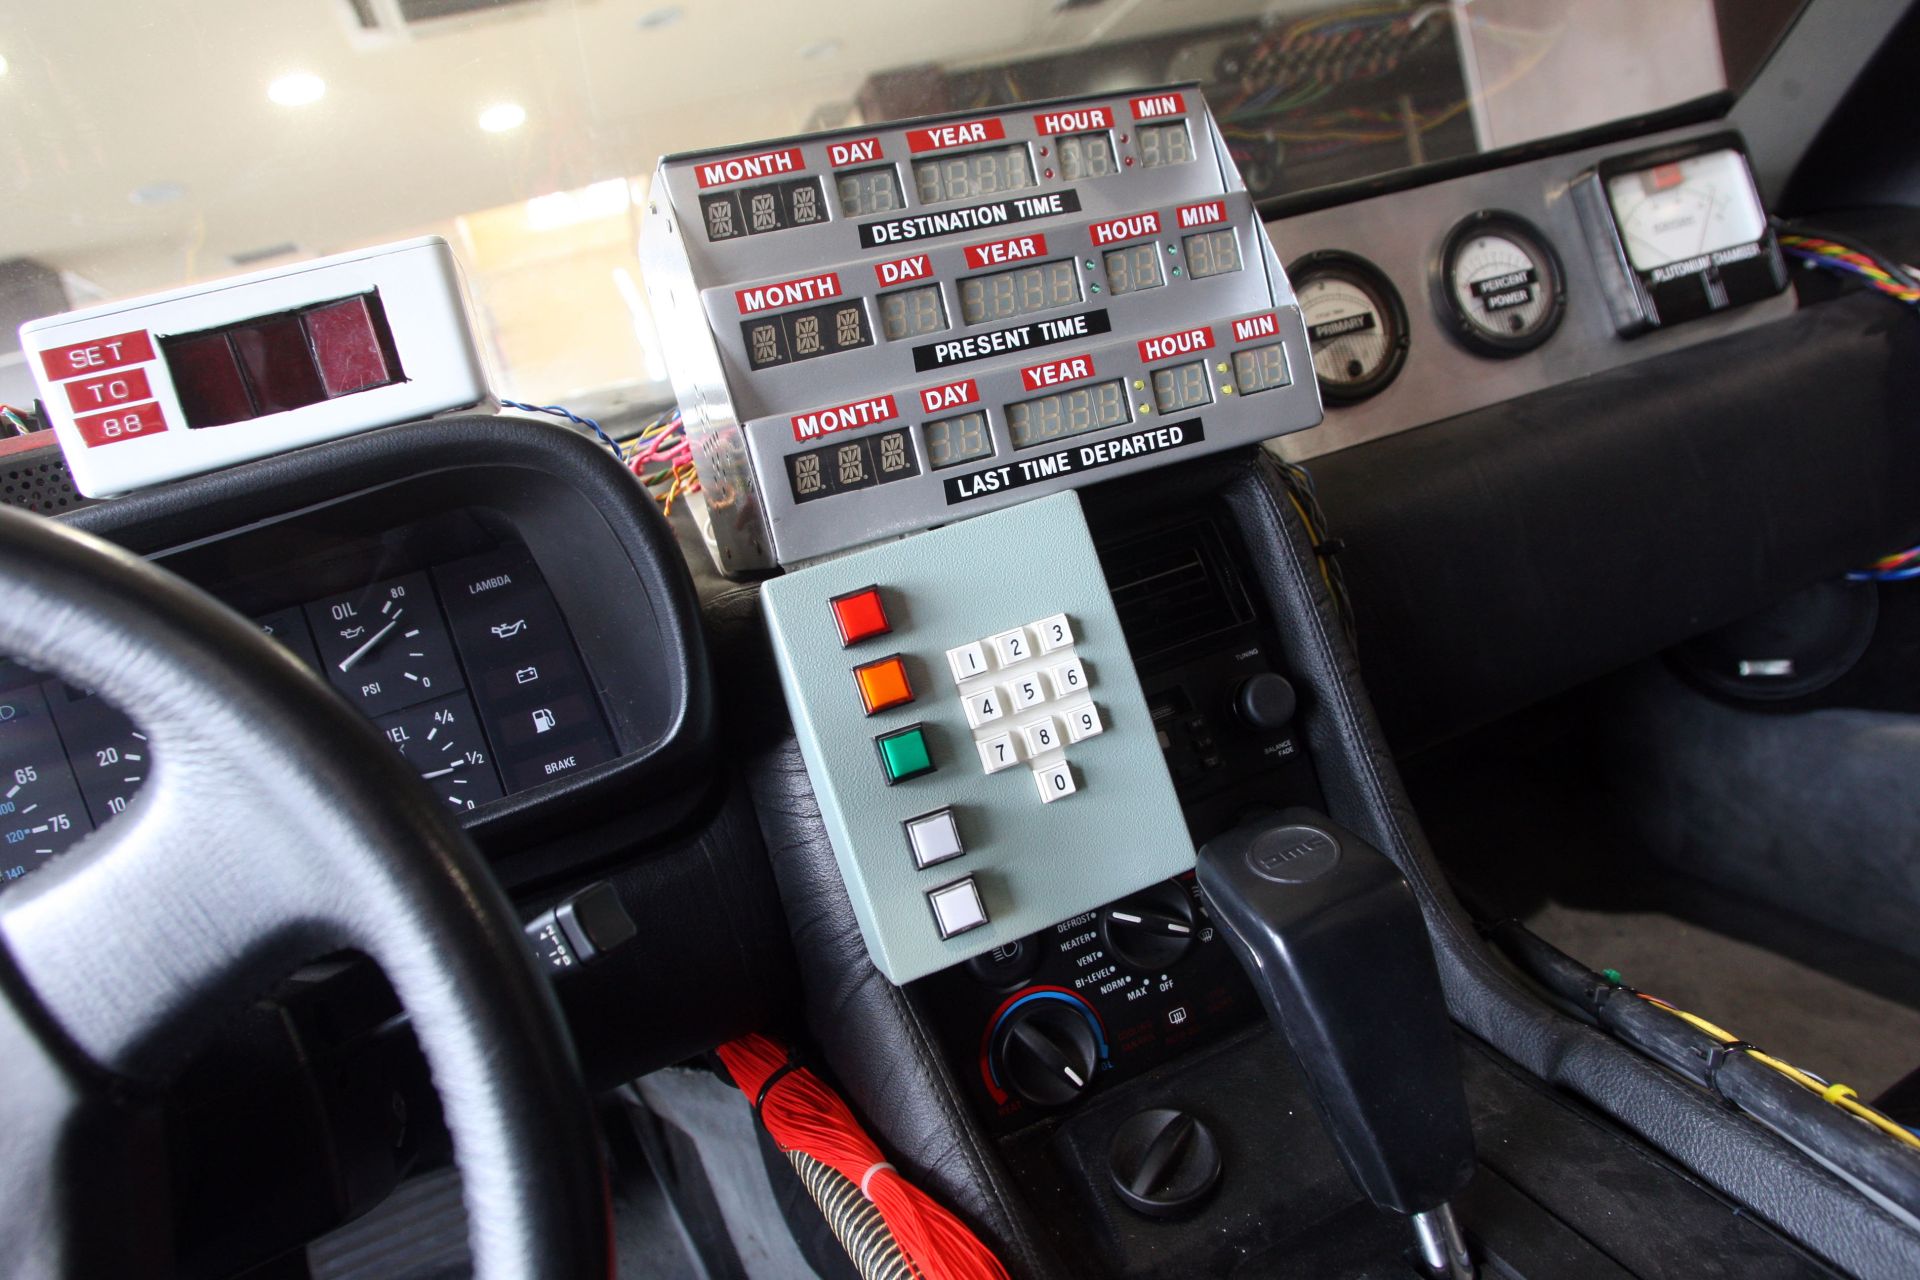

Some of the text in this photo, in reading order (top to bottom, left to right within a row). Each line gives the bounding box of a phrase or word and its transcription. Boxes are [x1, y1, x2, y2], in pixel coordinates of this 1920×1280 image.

[1139, 97, 1176, 118] MIN
[1045, 110, 1105, 133] HOUR
[928, 123, 986, 147] YEAR
[832, 141, 874, 165] DAY
[704, 152, 793, 184] MONTH
[872, 195, 1064, 244] DESTINATION TIME
[1182, 204, 1219, 226] MIN
[1097, 215, 1157, 243] HOUR
[976, 238, 1036, 266] YEAR
[882, 258, 924, 283] DAY
[1653, 255, 1711, 283] PLUTONIUM
[1481, 271, 1528, 292] PERCENT
[744, 277, 835, 311] MONTH
[1490, 289, 1528, 308] POWER
[1236, 316, 1274, 339] MIN
[1316, 315, 1365, 337] PRIMARY
[935, 316, 1087, 363] PRESENT TIME
[1145, 331, 1207, 359] HOUR
[70, 342, 122, 368] SET
[1028, 359, 1087, 386] YEAR
[87, 379, 129, 402] TO
[925, 383, 968, 410] DAY
[103, 414, 142, 437] 88
[797, 399, 889, 437] MONTH
[957, 426, 1183, 498] LAST TIME DEPARTED
[390, 586, 405, 599] 80
[469, 574, 512, 595] LAMBDA
[331, 602, 357, 621] OIL
[968, 624, 1063, 669] 1 2 3
[362, 682, 381, 697] PSI
[422, 676, 431, 688] 0
[982, 669, 1078, 715] 4 5 6
[434, 709, 454, 724] 4/4
[995, 714, 1092, 762] 7 8 9
[96, 747, 119, 767] 20
[465, 751, 484, 765] 1/2
[544, 756, 577, 775] BRAKE
[14, 765, 37, 785] 65
[1054, 774, 1066, 791] 0
[0, 801, 15, 816] 00
[107, 797, 126, 814] 10
[467, 800, 475, 810] 0
[48, 814, 70, 833] 75
[6, 829, 25, 843] 120
[1057, 914, 1091, 933] DEFROST
[1061, 934, 1091, 952] HEATER
[1077, 952, 1098, 968] VENT
[1075, 968, 1111, 989] BI-LEVEL
[1100, 978, 1126, 995] NORM
[1160, 979, 1174, 992] OFF
[1127, 987, 1147, 1001] MAX
